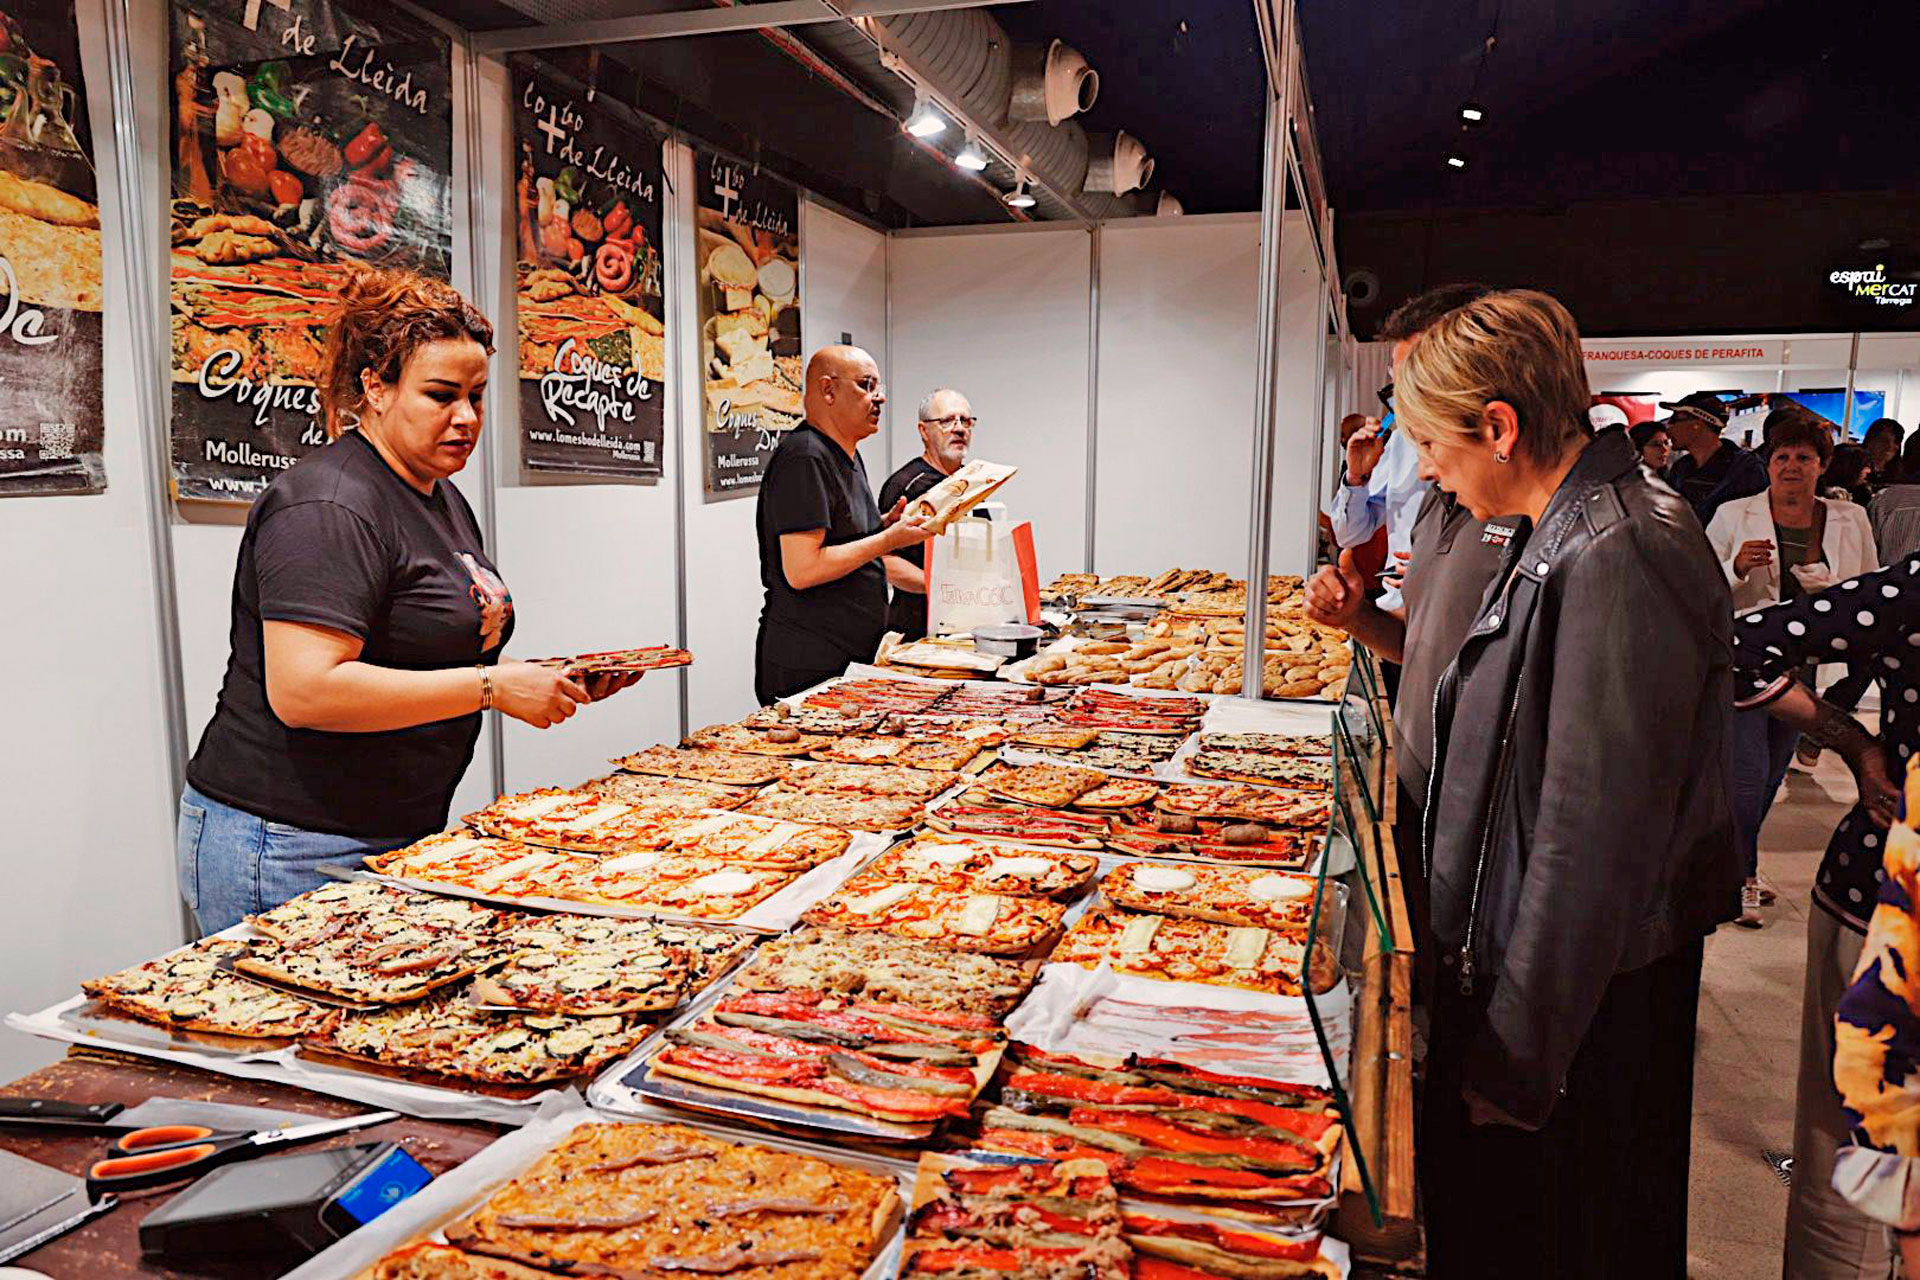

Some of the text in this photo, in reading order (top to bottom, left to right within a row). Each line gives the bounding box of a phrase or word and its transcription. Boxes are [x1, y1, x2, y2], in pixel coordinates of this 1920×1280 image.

[281, 15, 315, 55] de
[560, 137, 583, 166] de
[1829, 263, 1886, 291] espai
[1695, 349, 1709, 358] DE
[1712, 348, 1764, 358] PERAFITA
[554, 338, 652, 400] Coques de
[199, 350, 321, 426] Coques
[541, 372, 636, 432] Recapte
[301, 421, 323, 445] de
[717, 398, 758, 439] Coques
[755, 426, 781, 452] Dol
[206, 440, 300, 470] Mollerus
[717, 454, 759, 469] Mollerussa
